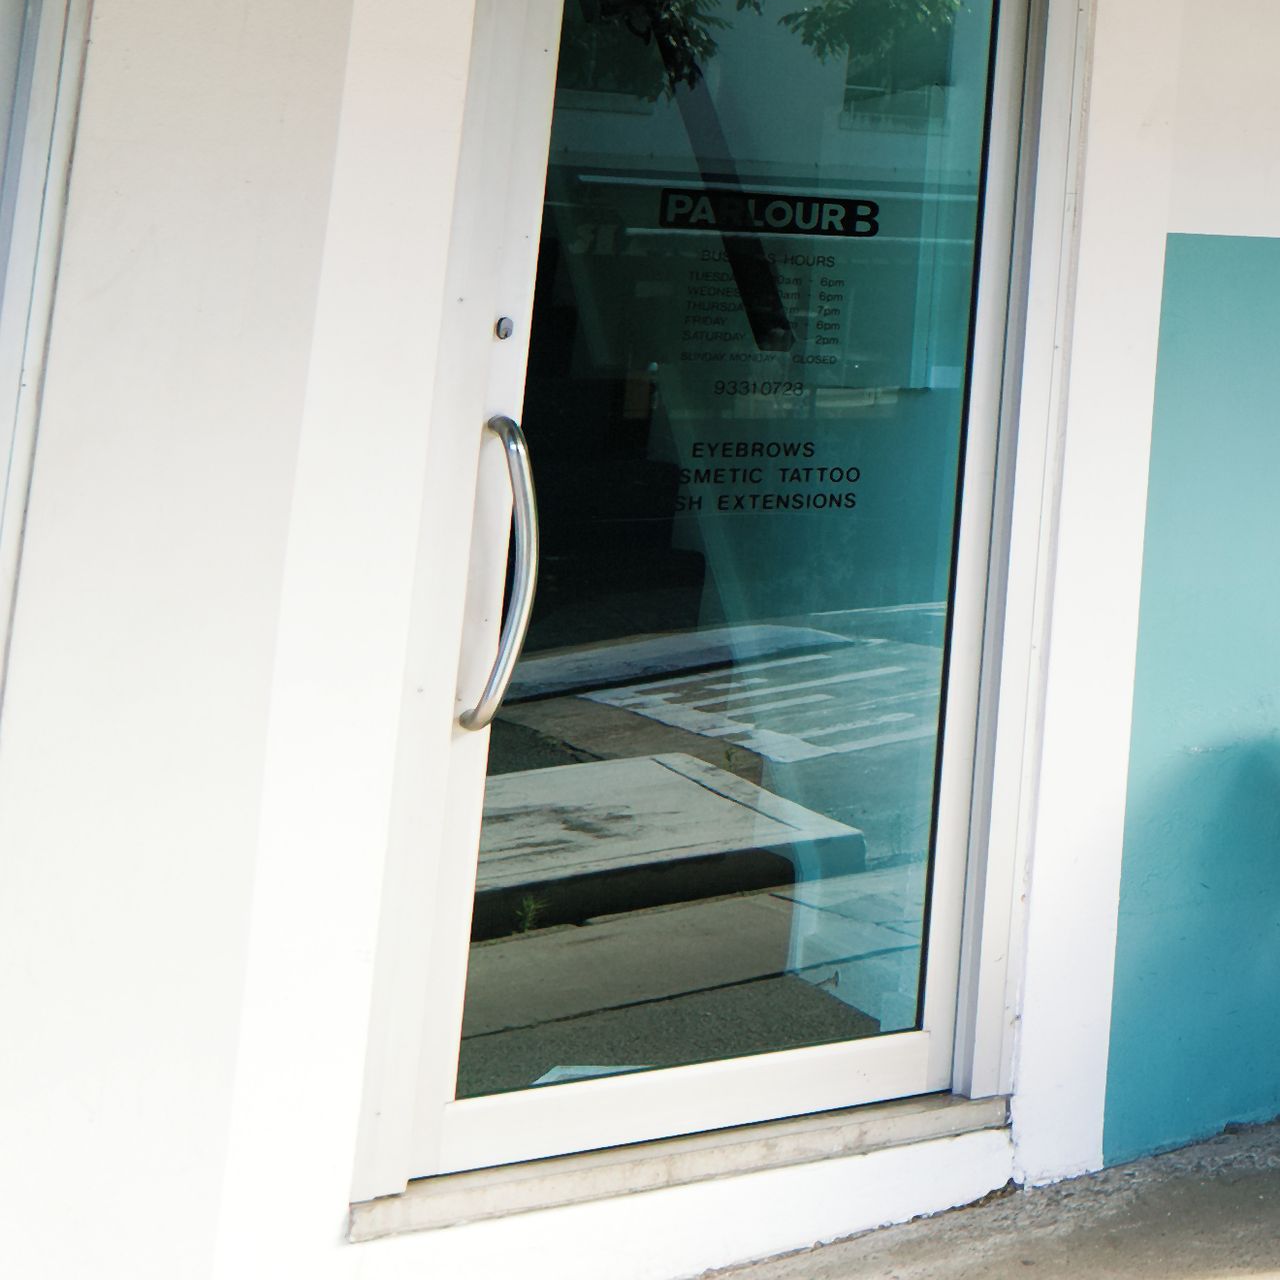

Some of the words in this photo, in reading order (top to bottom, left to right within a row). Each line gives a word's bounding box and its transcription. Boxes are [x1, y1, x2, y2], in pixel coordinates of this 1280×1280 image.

[666, 194, 846, 231] PALOUR
[851, 201, 879, 237] B
[784, 254, 836, 268] HOURS
[689, 271, 738, 283] TUESDA
[686, 300, 746, 313] THURSDA
[792, 354, 838, 365] CLOSED
[692, 442, 816, 458] EYEBROWS
[677, 468, 764, 484] SMETIC
[779, 467, 861, 483] TATTOO
[717, 493, 857, 511] EXTENSIONS
